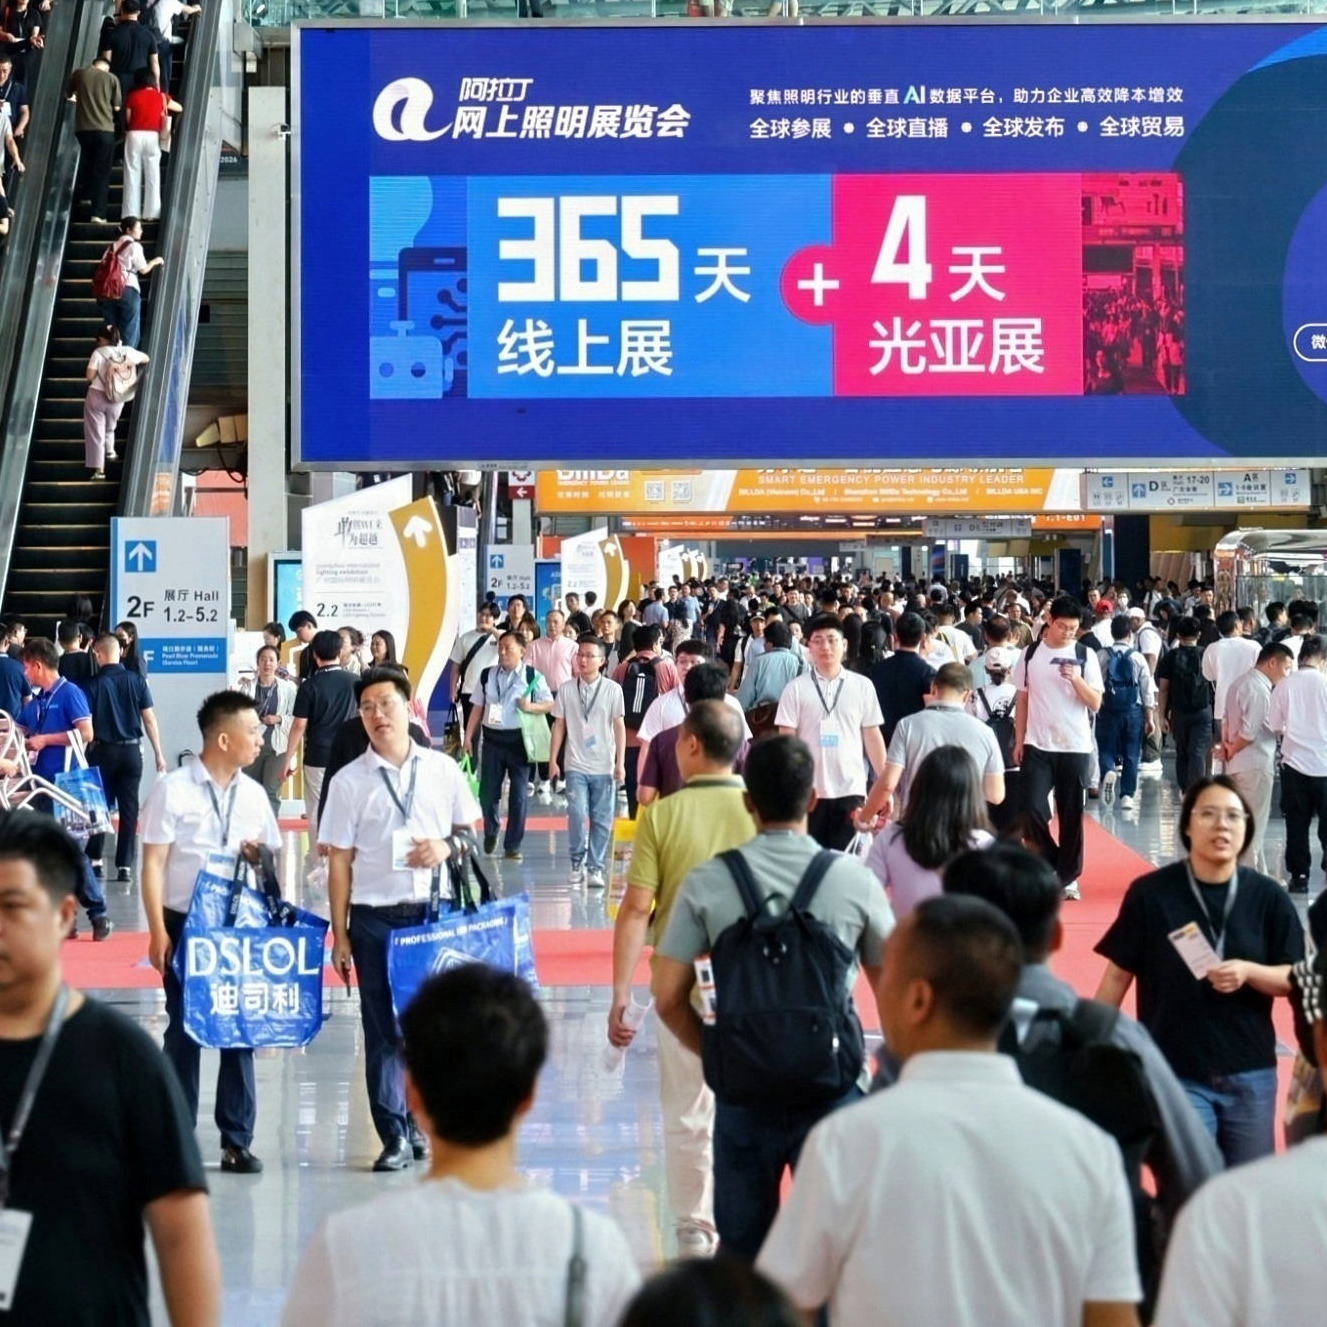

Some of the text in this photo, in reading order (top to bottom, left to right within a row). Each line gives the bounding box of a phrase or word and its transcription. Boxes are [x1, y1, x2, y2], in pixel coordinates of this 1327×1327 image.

[459, 77, 534, 102] 阿拉丁
[452, 104, 691, 140] 网上照明展览会
[496, 318, 674, 377] 线上展
[868, 316, 1045, 375] 光亚展
[758, 475, 1024, 484] SMART EMERGENCY POWER INDUSTRY LEADER
[127, 596, 218, 623] 2F 1.2-5.2
[164, 589, 219, 601] 展厅 Hall
[317, 603, 338, 617] 2.2
[188, 937, 320, 976] DSLOL
[210, 982, 300, 1016] 迪司利
